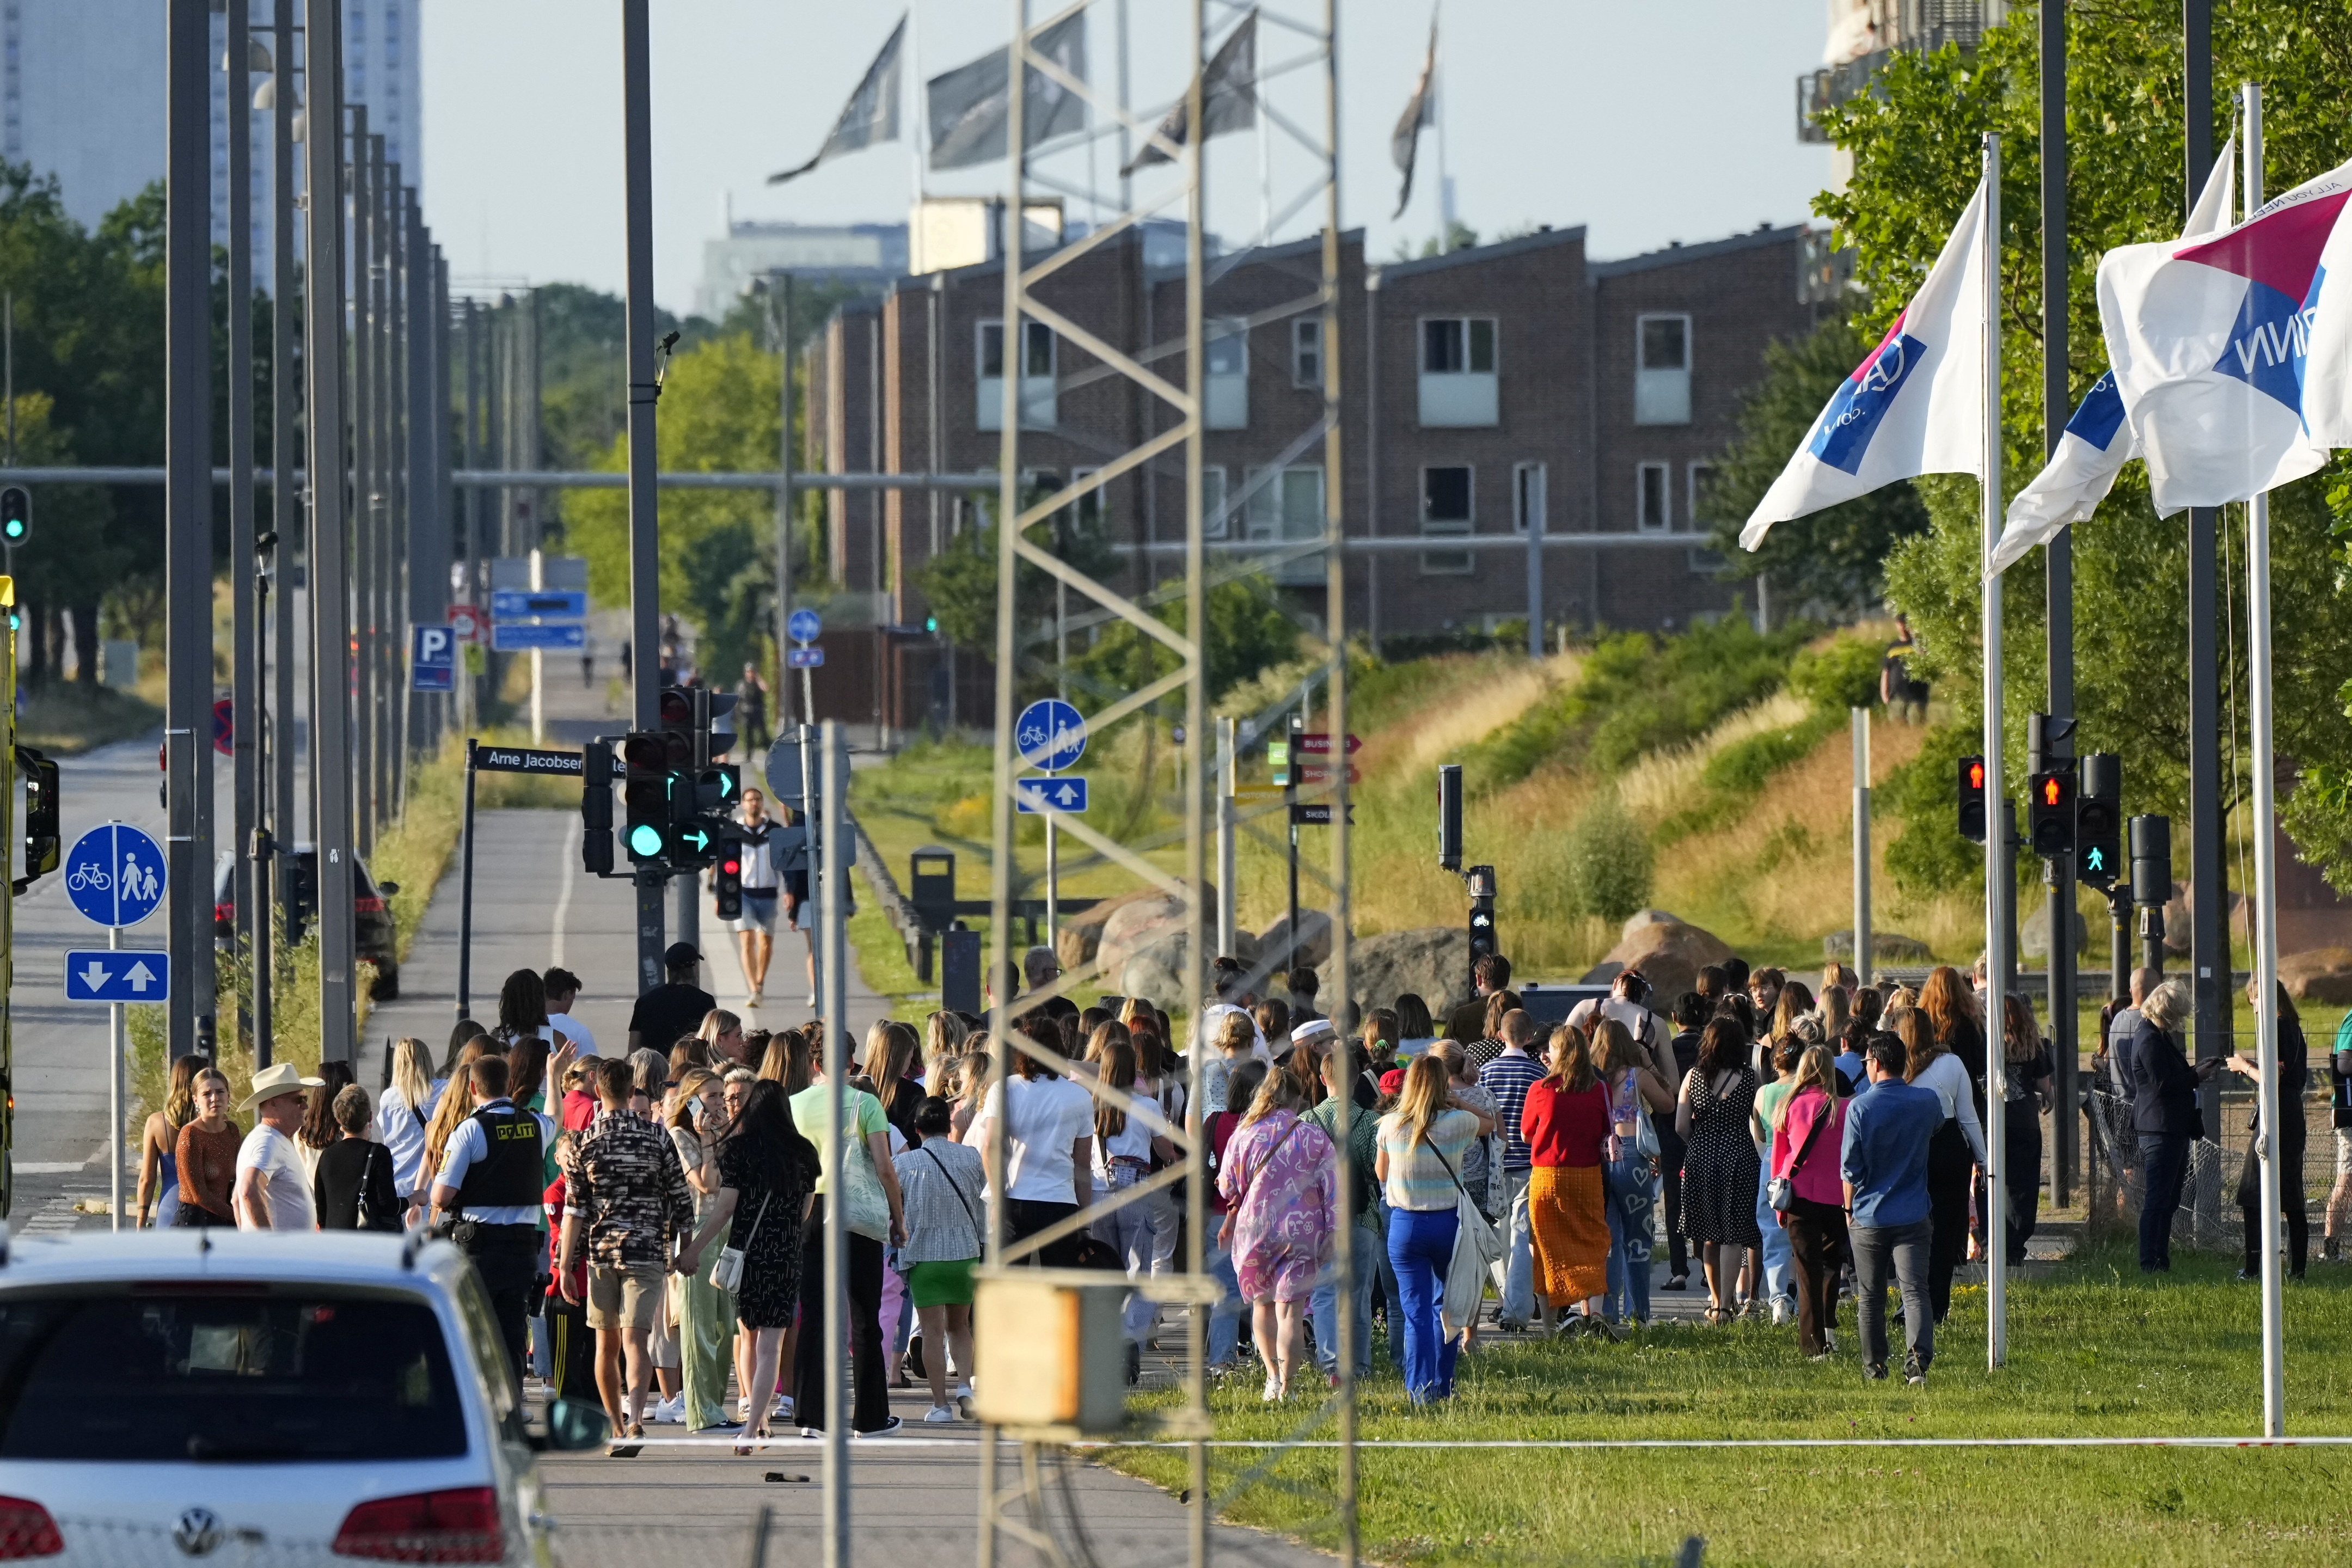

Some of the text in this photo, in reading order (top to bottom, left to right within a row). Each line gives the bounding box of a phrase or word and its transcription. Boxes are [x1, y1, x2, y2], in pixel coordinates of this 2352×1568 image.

[421, 629, 446, 661] P
[489, 752, 520, 765] Arne
[497, 1125, 534, 1138] POLITI
